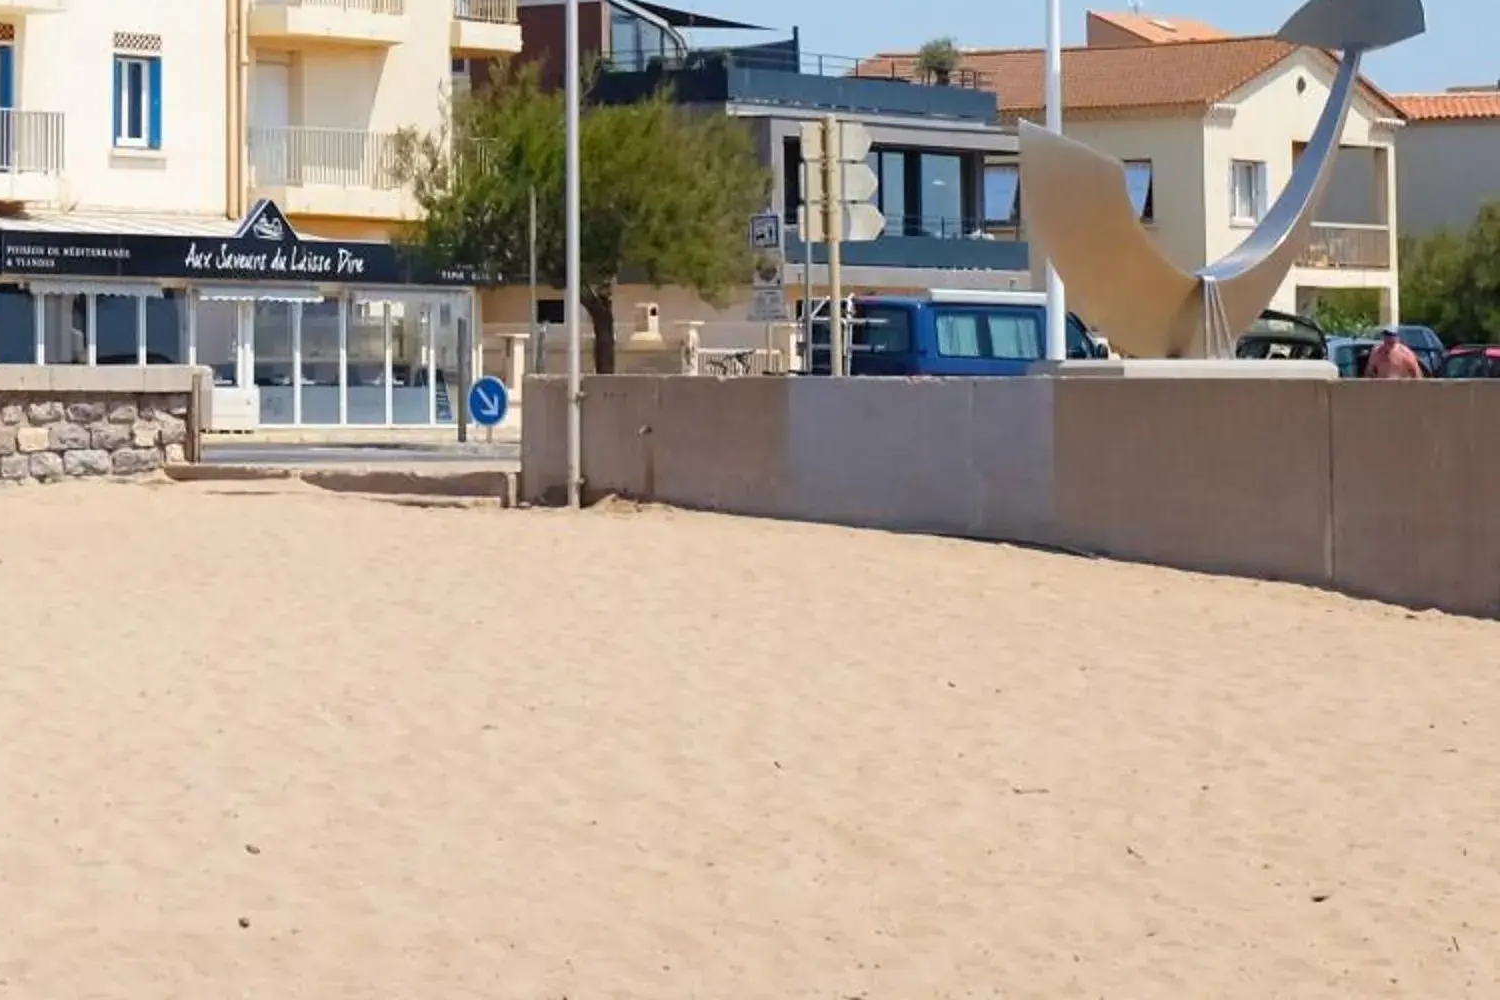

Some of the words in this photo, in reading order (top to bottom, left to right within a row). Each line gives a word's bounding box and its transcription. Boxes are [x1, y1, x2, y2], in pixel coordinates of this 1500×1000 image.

[185, 241, 212, 269] Aux
[215, 242, 267, 271] Saveurs
[270, 247, 287, 271] du
[291, 245, 331, 272] Laisse
[336, 247, 365, 273] Dire
